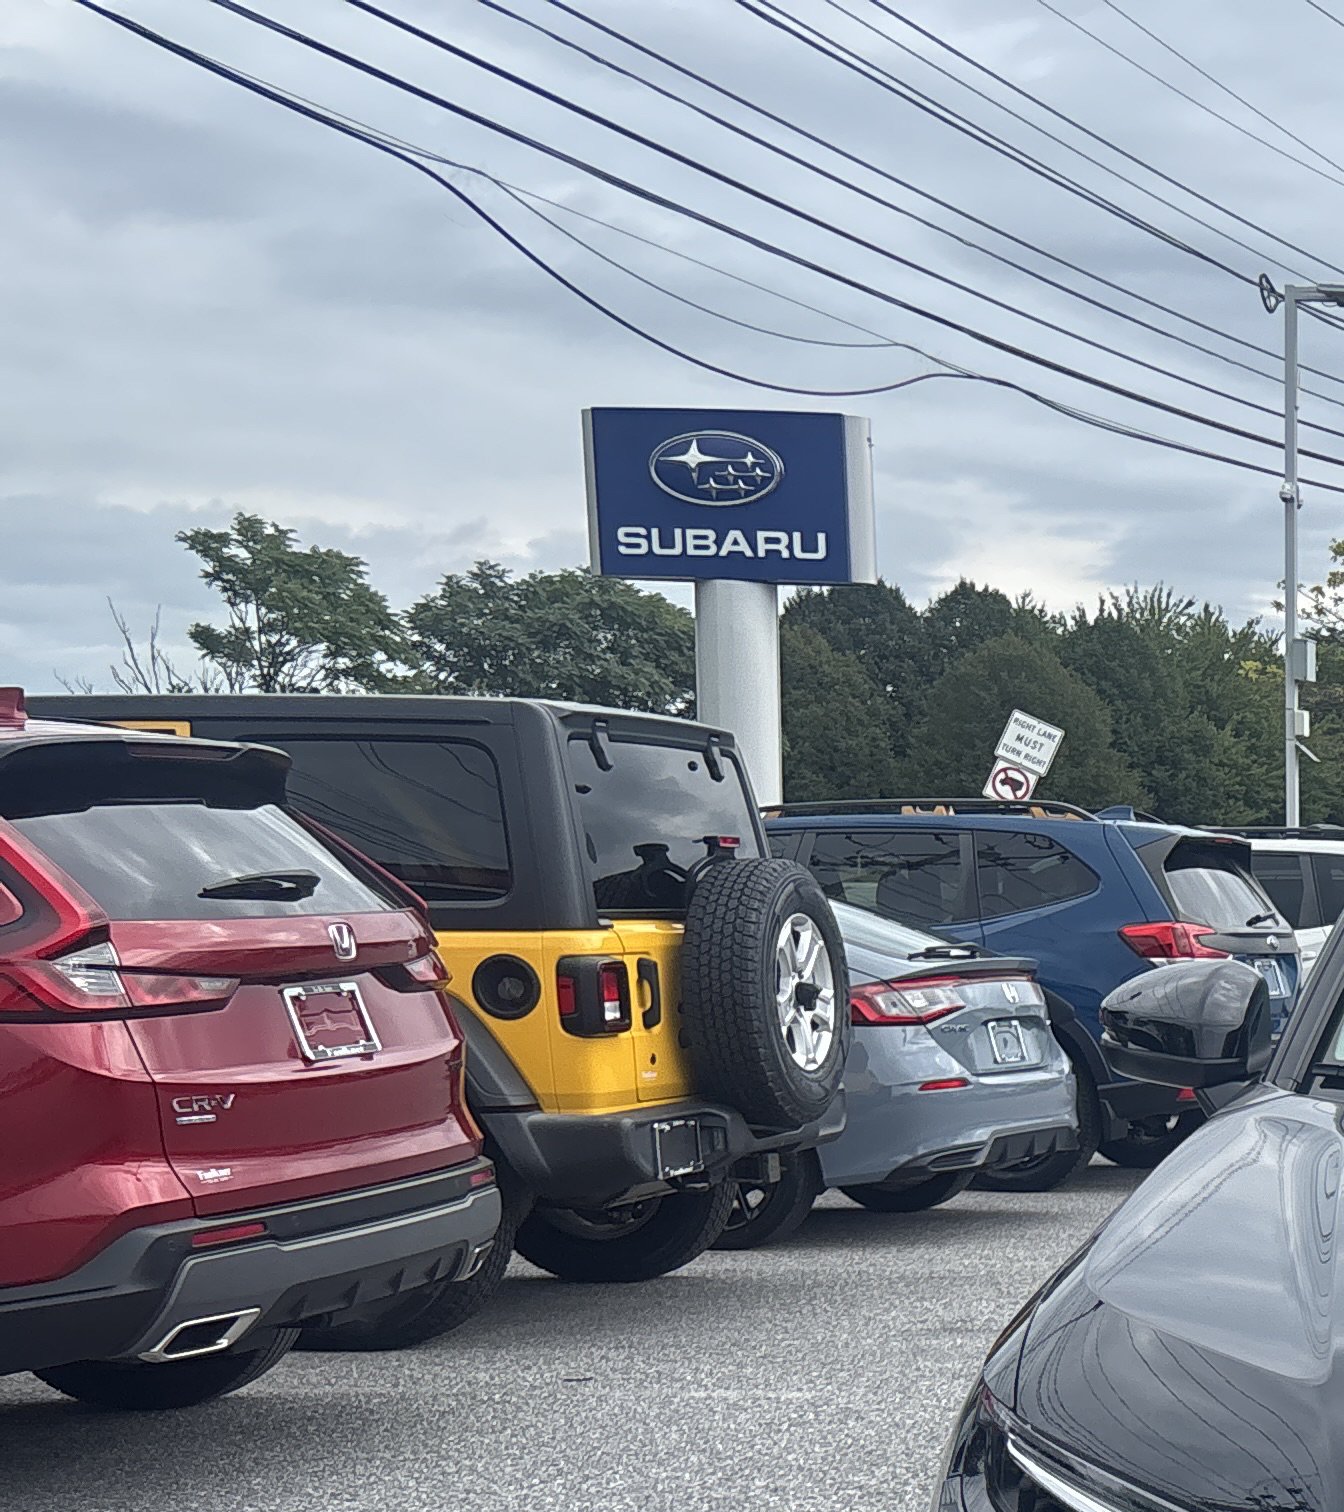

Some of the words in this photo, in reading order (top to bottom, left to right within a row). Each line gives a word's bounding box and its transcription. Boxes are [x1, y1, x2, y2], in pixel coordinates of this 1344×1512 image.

[616, 526, 828, 560] SUBARU
[1012, 717, 1037, 733] RIGHT
[1036, 727, 1058, 743] LANE
[1014, 733, 1045, 752] MUST
[1001, 742, 1024, 758] TURN
[1023, 752, 1047, 768] RIGHT
[172, 1093, 236, 1113] CR-V
